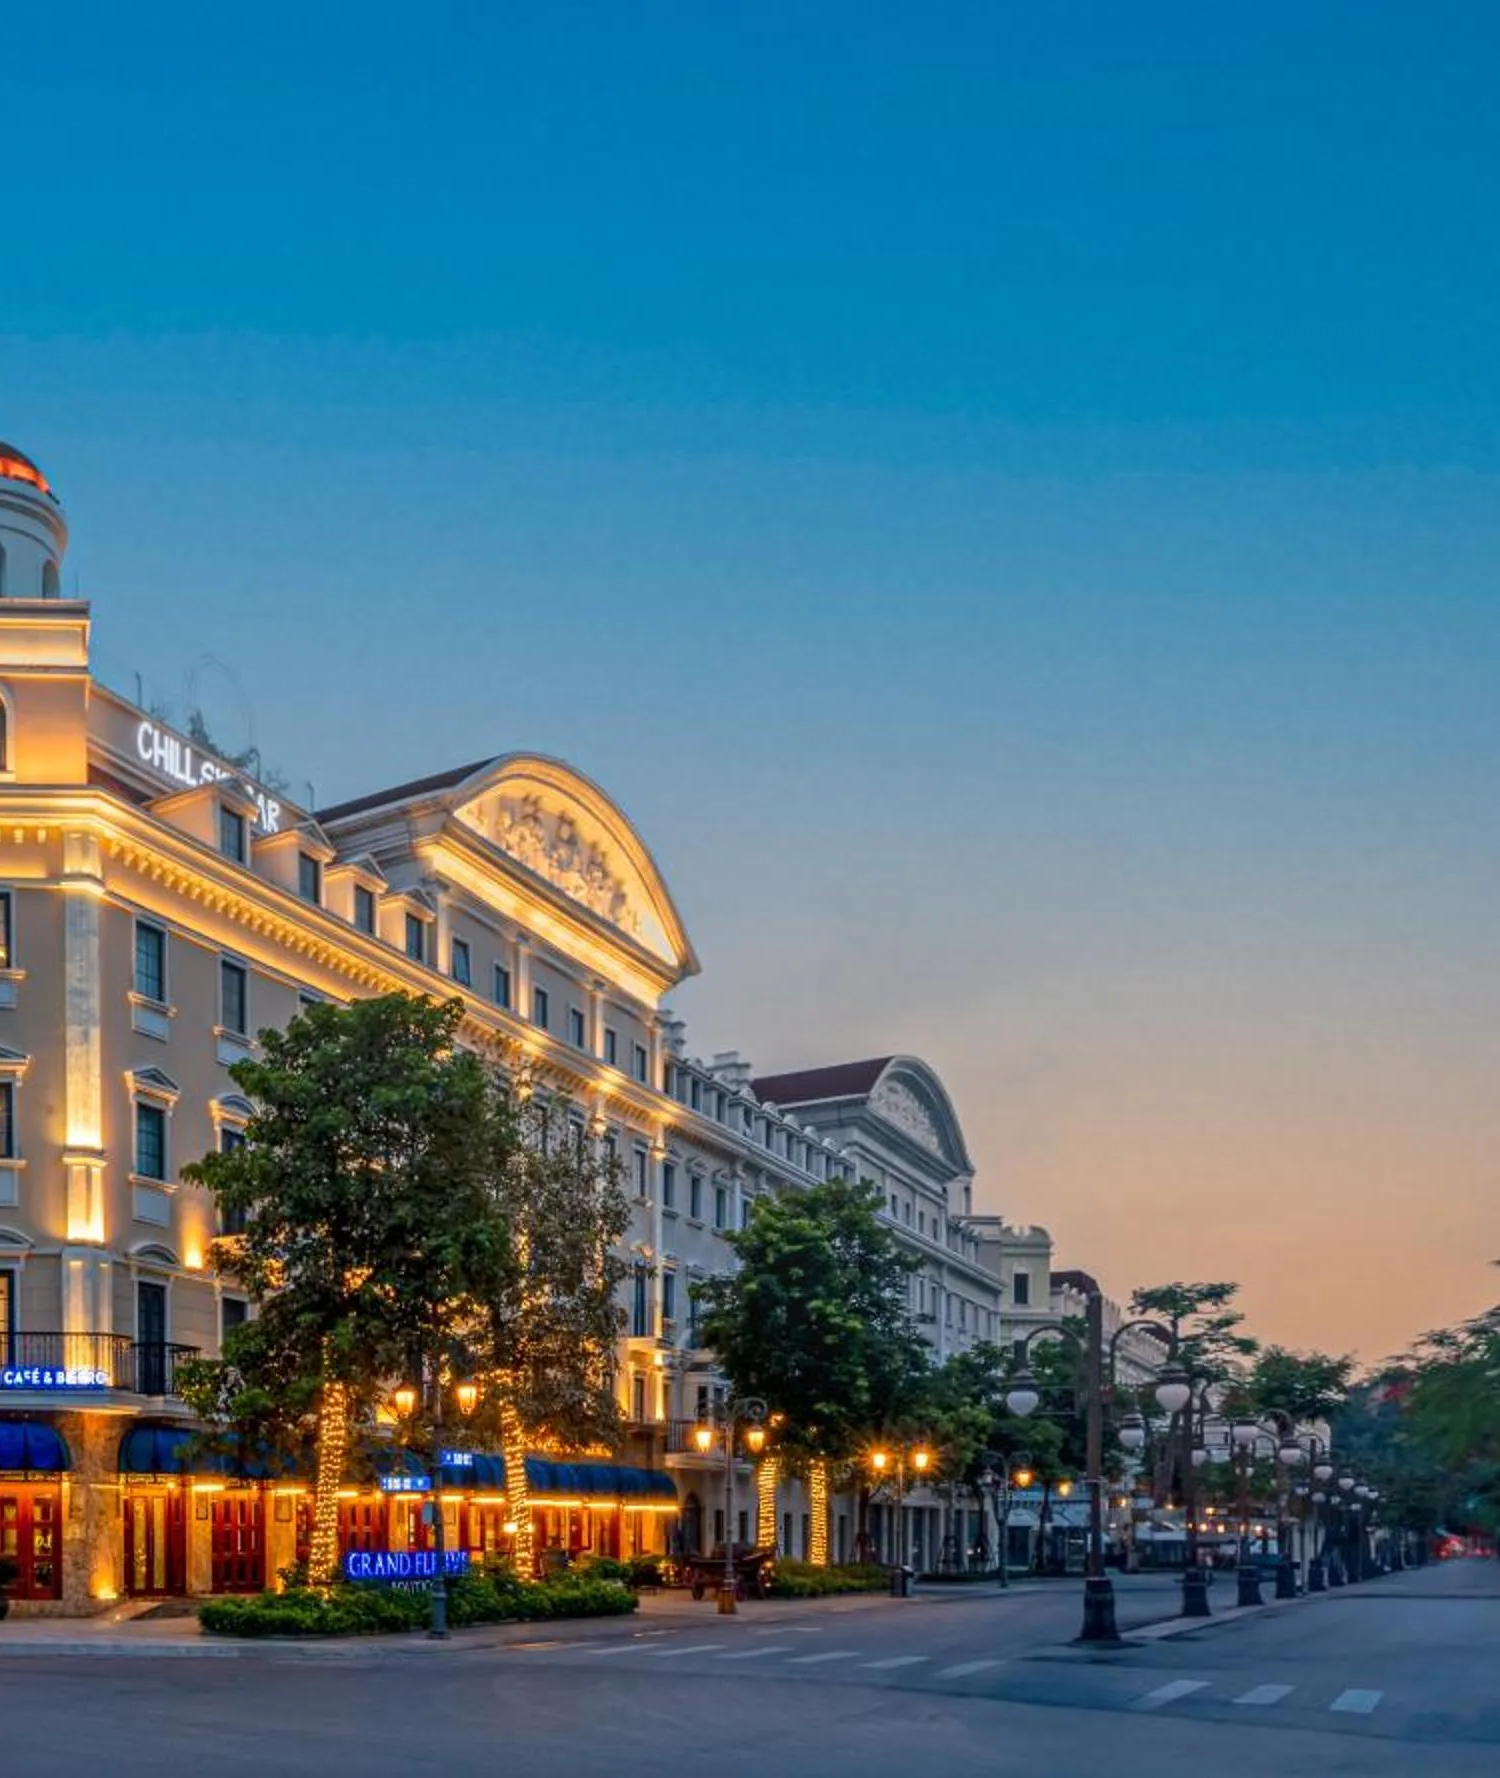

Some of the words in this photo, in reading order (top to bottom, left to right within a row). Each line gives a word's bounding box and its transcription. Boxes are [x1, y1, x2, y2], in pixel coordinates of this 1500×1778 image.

[137, 721, 197, 787] CHILL
[43, 1371, 53, 1385] &
[348, 1552, 411, 1577] GRAND
